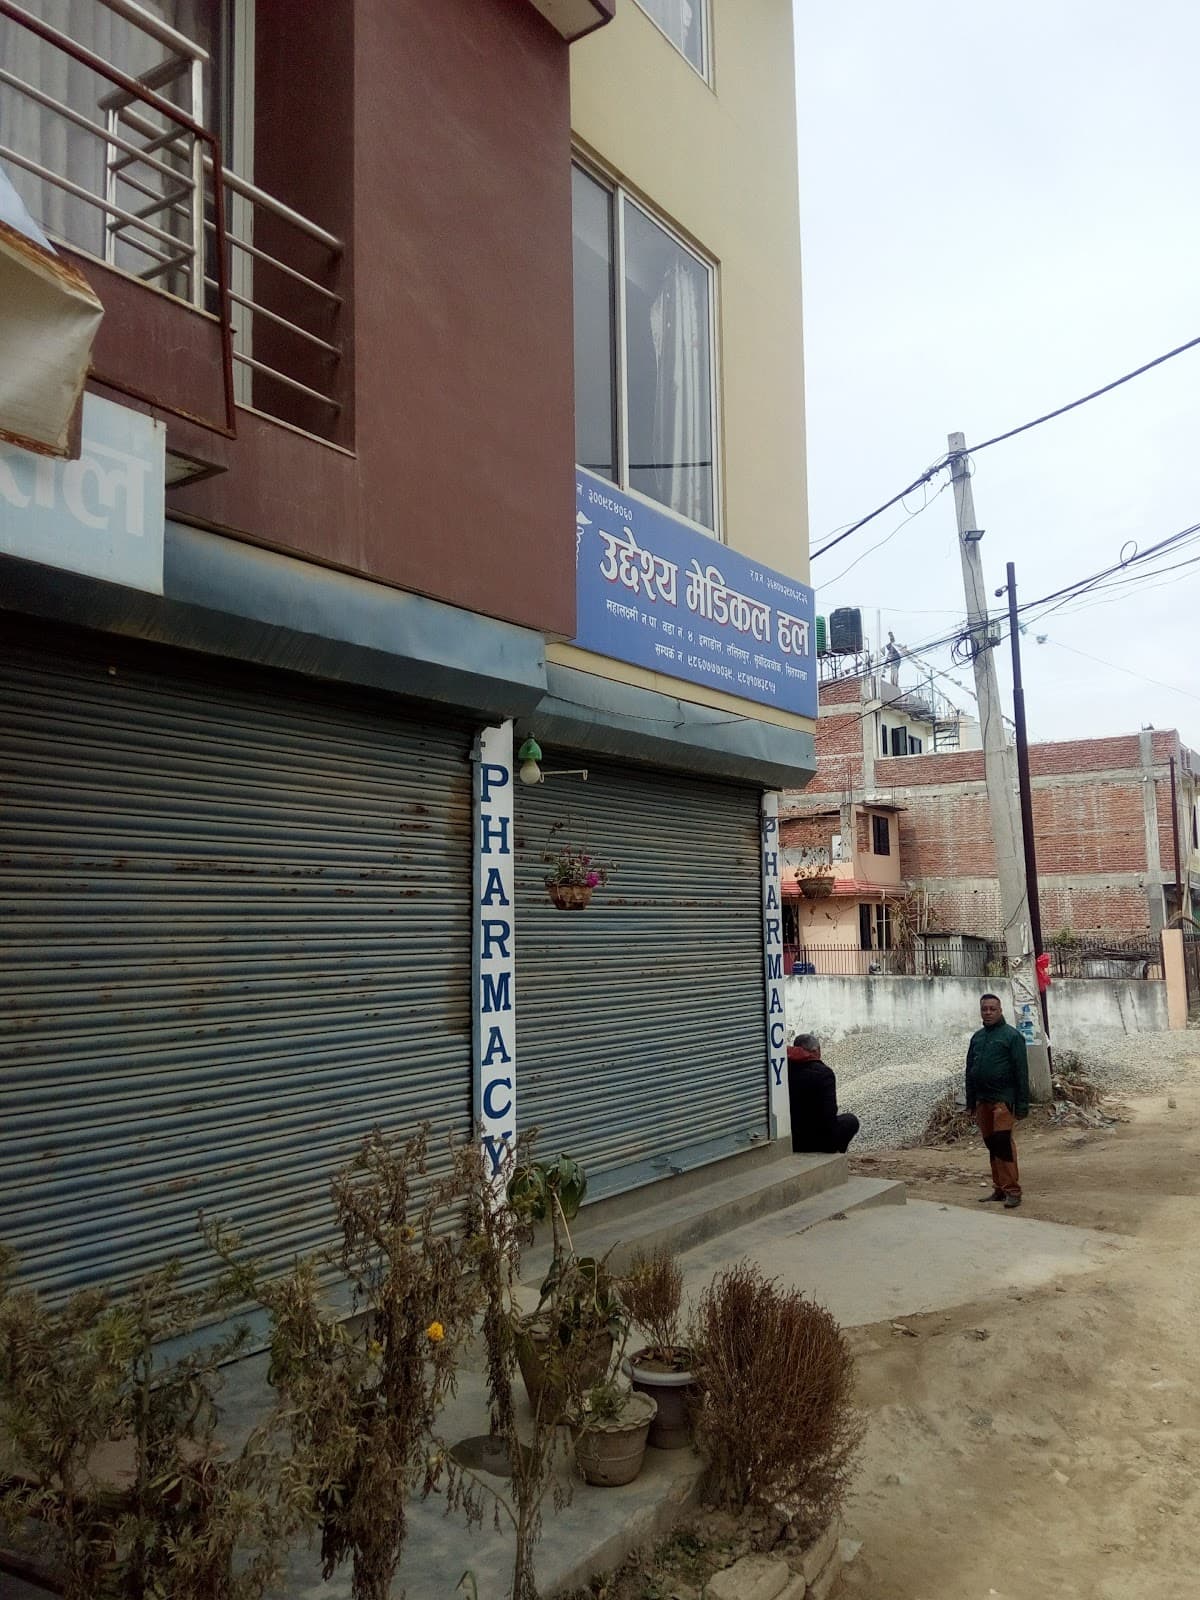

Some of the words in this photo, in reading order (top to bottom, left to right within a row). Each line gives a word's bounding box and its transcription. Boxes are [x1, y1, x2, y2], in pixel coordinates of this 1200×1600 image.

[599, 526, 678, 606] उद्देश्य
[685, 559, 772, 642] मेडिकल
[776, 609, 809, 656] हल
[605, 599, 639, 622] महालक्ष्मी
[662, 620, 675, 636] वडा
[480, 763, 512, 1178] PHARMACY
[762, 816, 785, 1086] PHARMACY
